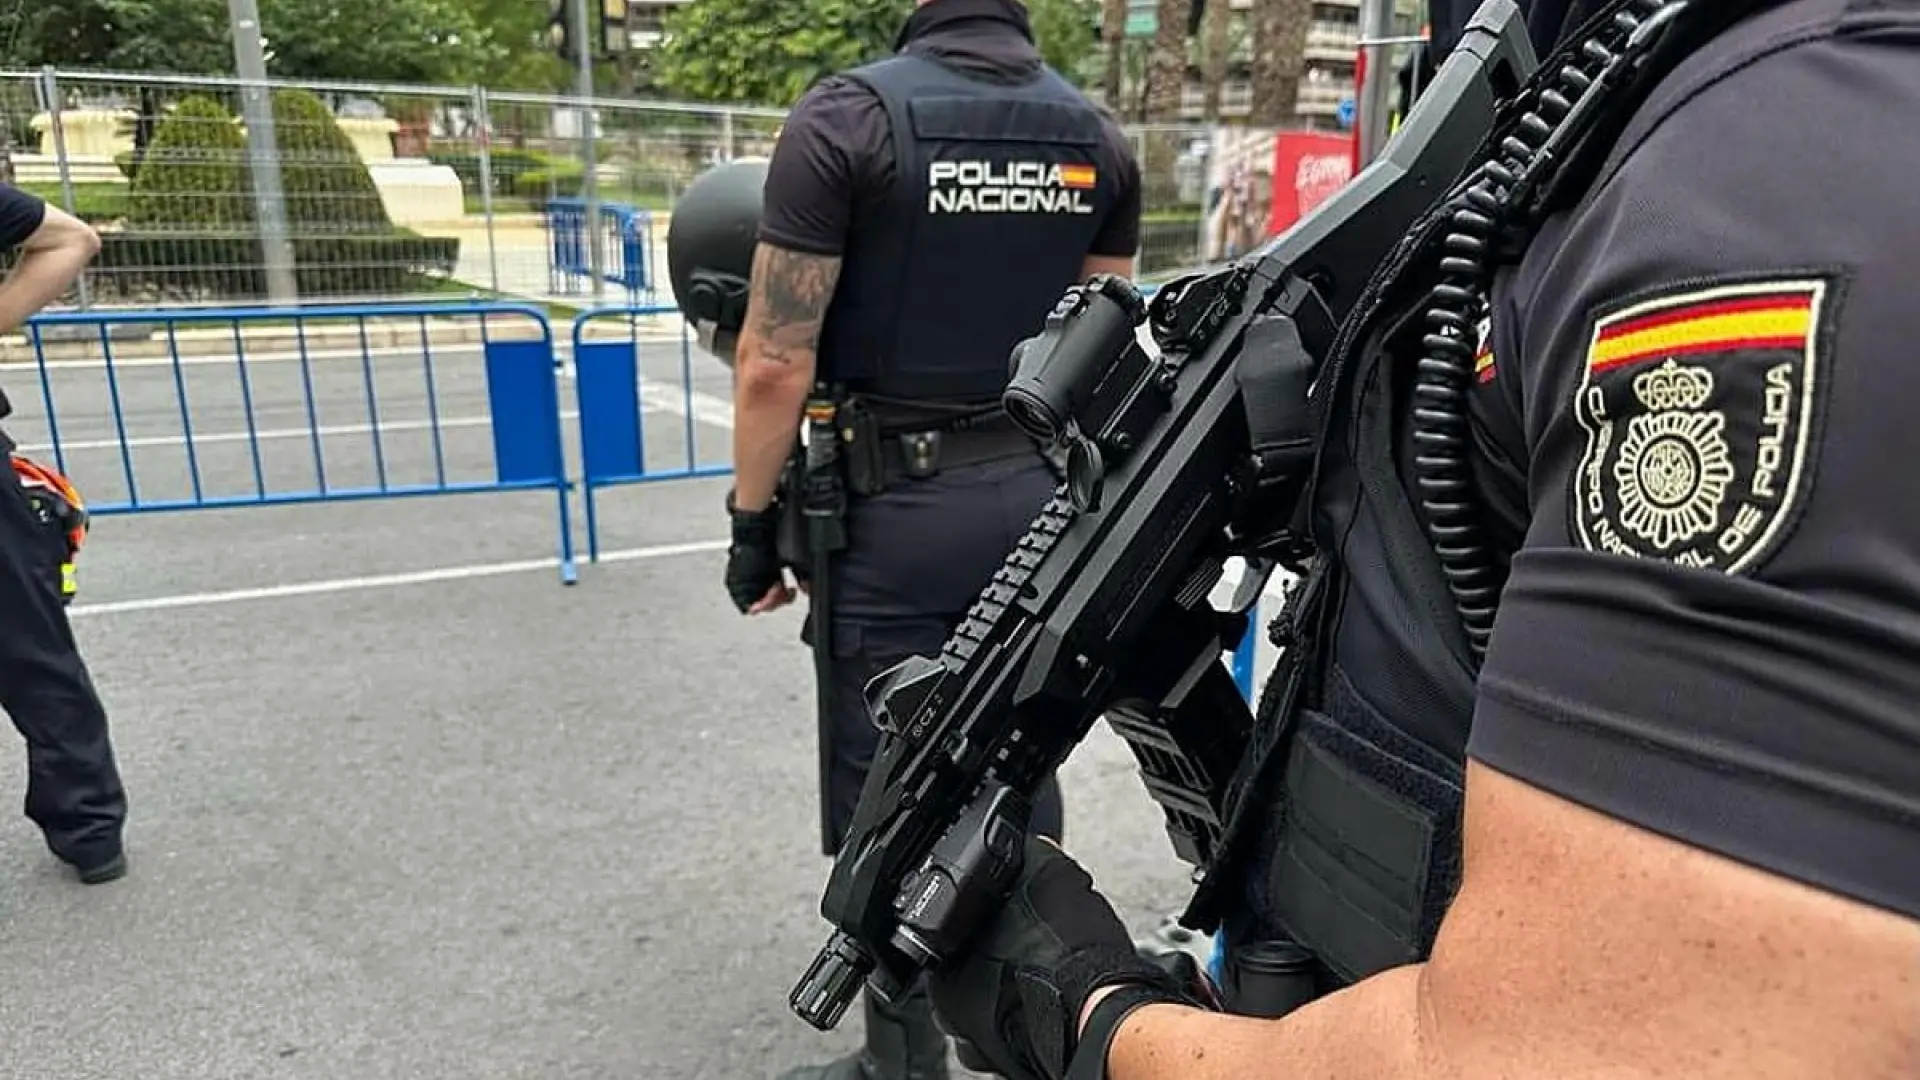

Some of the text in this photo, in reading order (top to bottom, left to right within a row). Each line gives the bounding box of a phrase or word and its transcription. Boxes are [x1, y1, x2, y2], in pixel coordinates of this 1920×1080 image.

[929, 161, 1064, 187] POLICIA
[928, 187, 1092, 213] NACIONAL
[1718, 502, 1763, 554] DE
[1752, 362, 1793, 497] POLICIA
